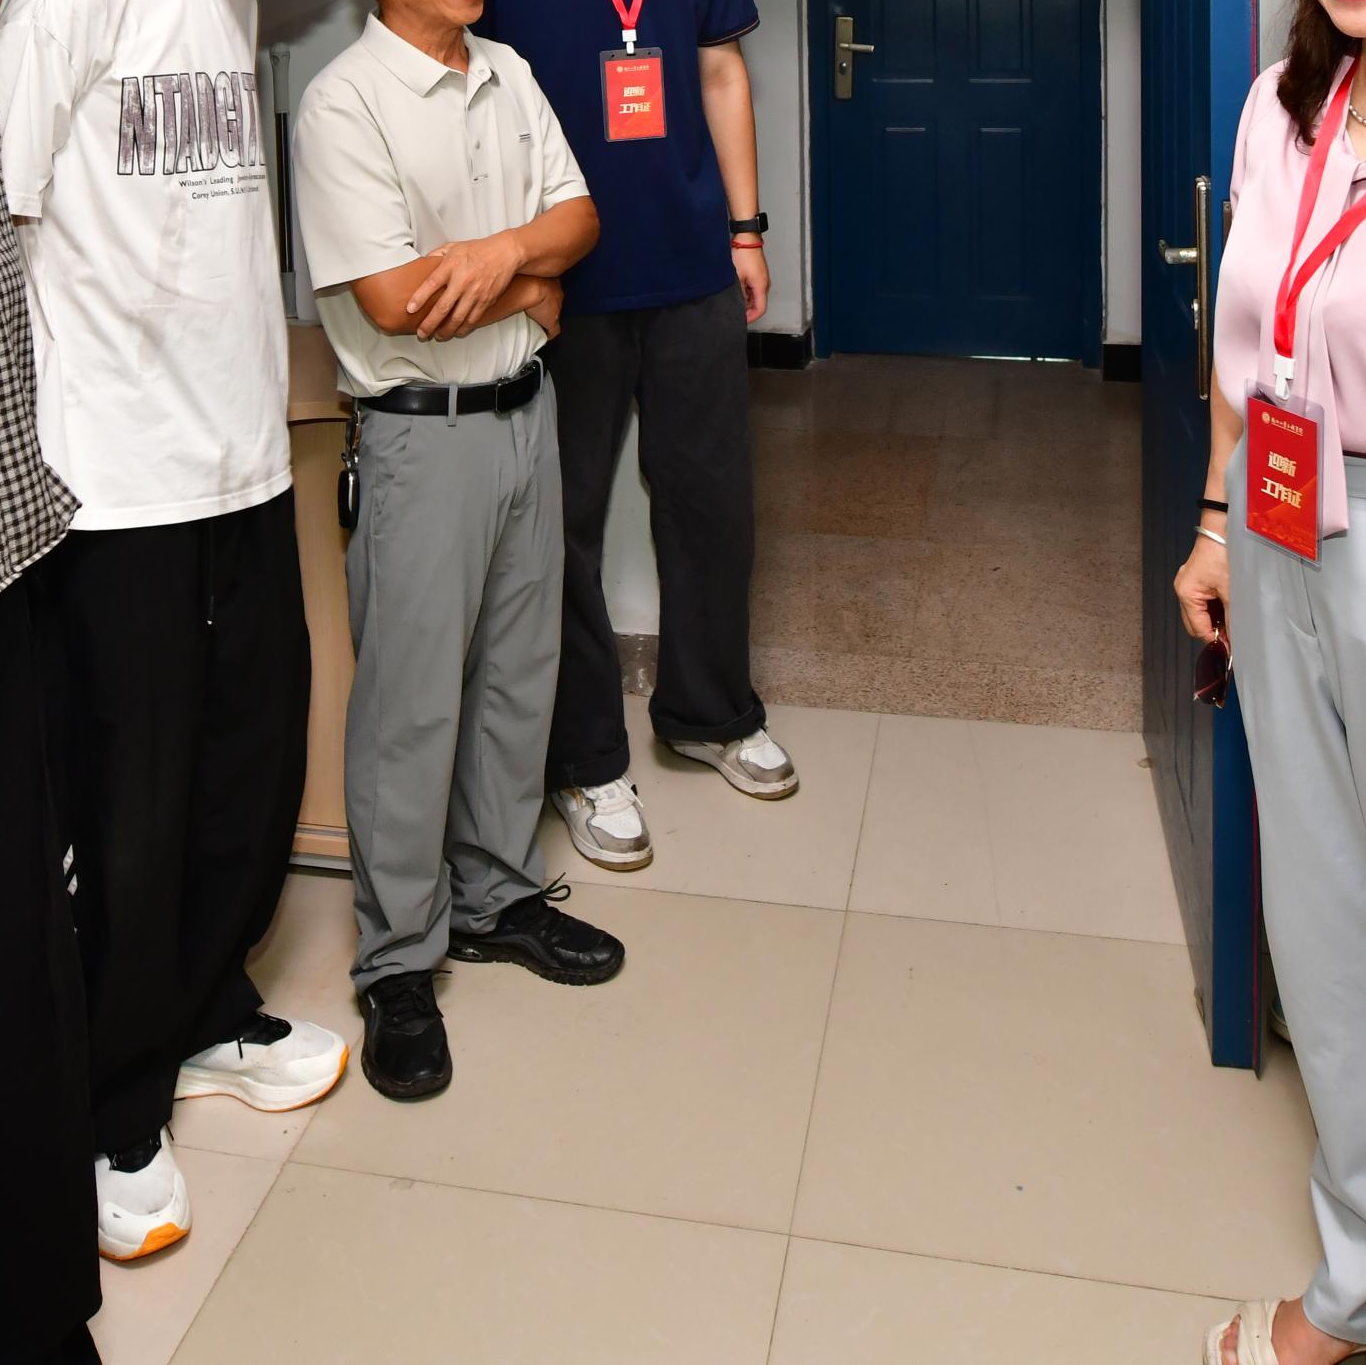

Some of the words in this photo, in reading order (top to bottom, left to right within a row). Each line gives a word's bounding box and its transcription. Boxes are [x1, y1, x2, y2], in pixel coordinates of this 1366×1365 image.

[623, 85, 646, 98] 迎新
[618, 101, 652, 114] 工作证
[1267, 450, 1297, 479] 迎新
[1260, 476, 1303, 509] 工作证
